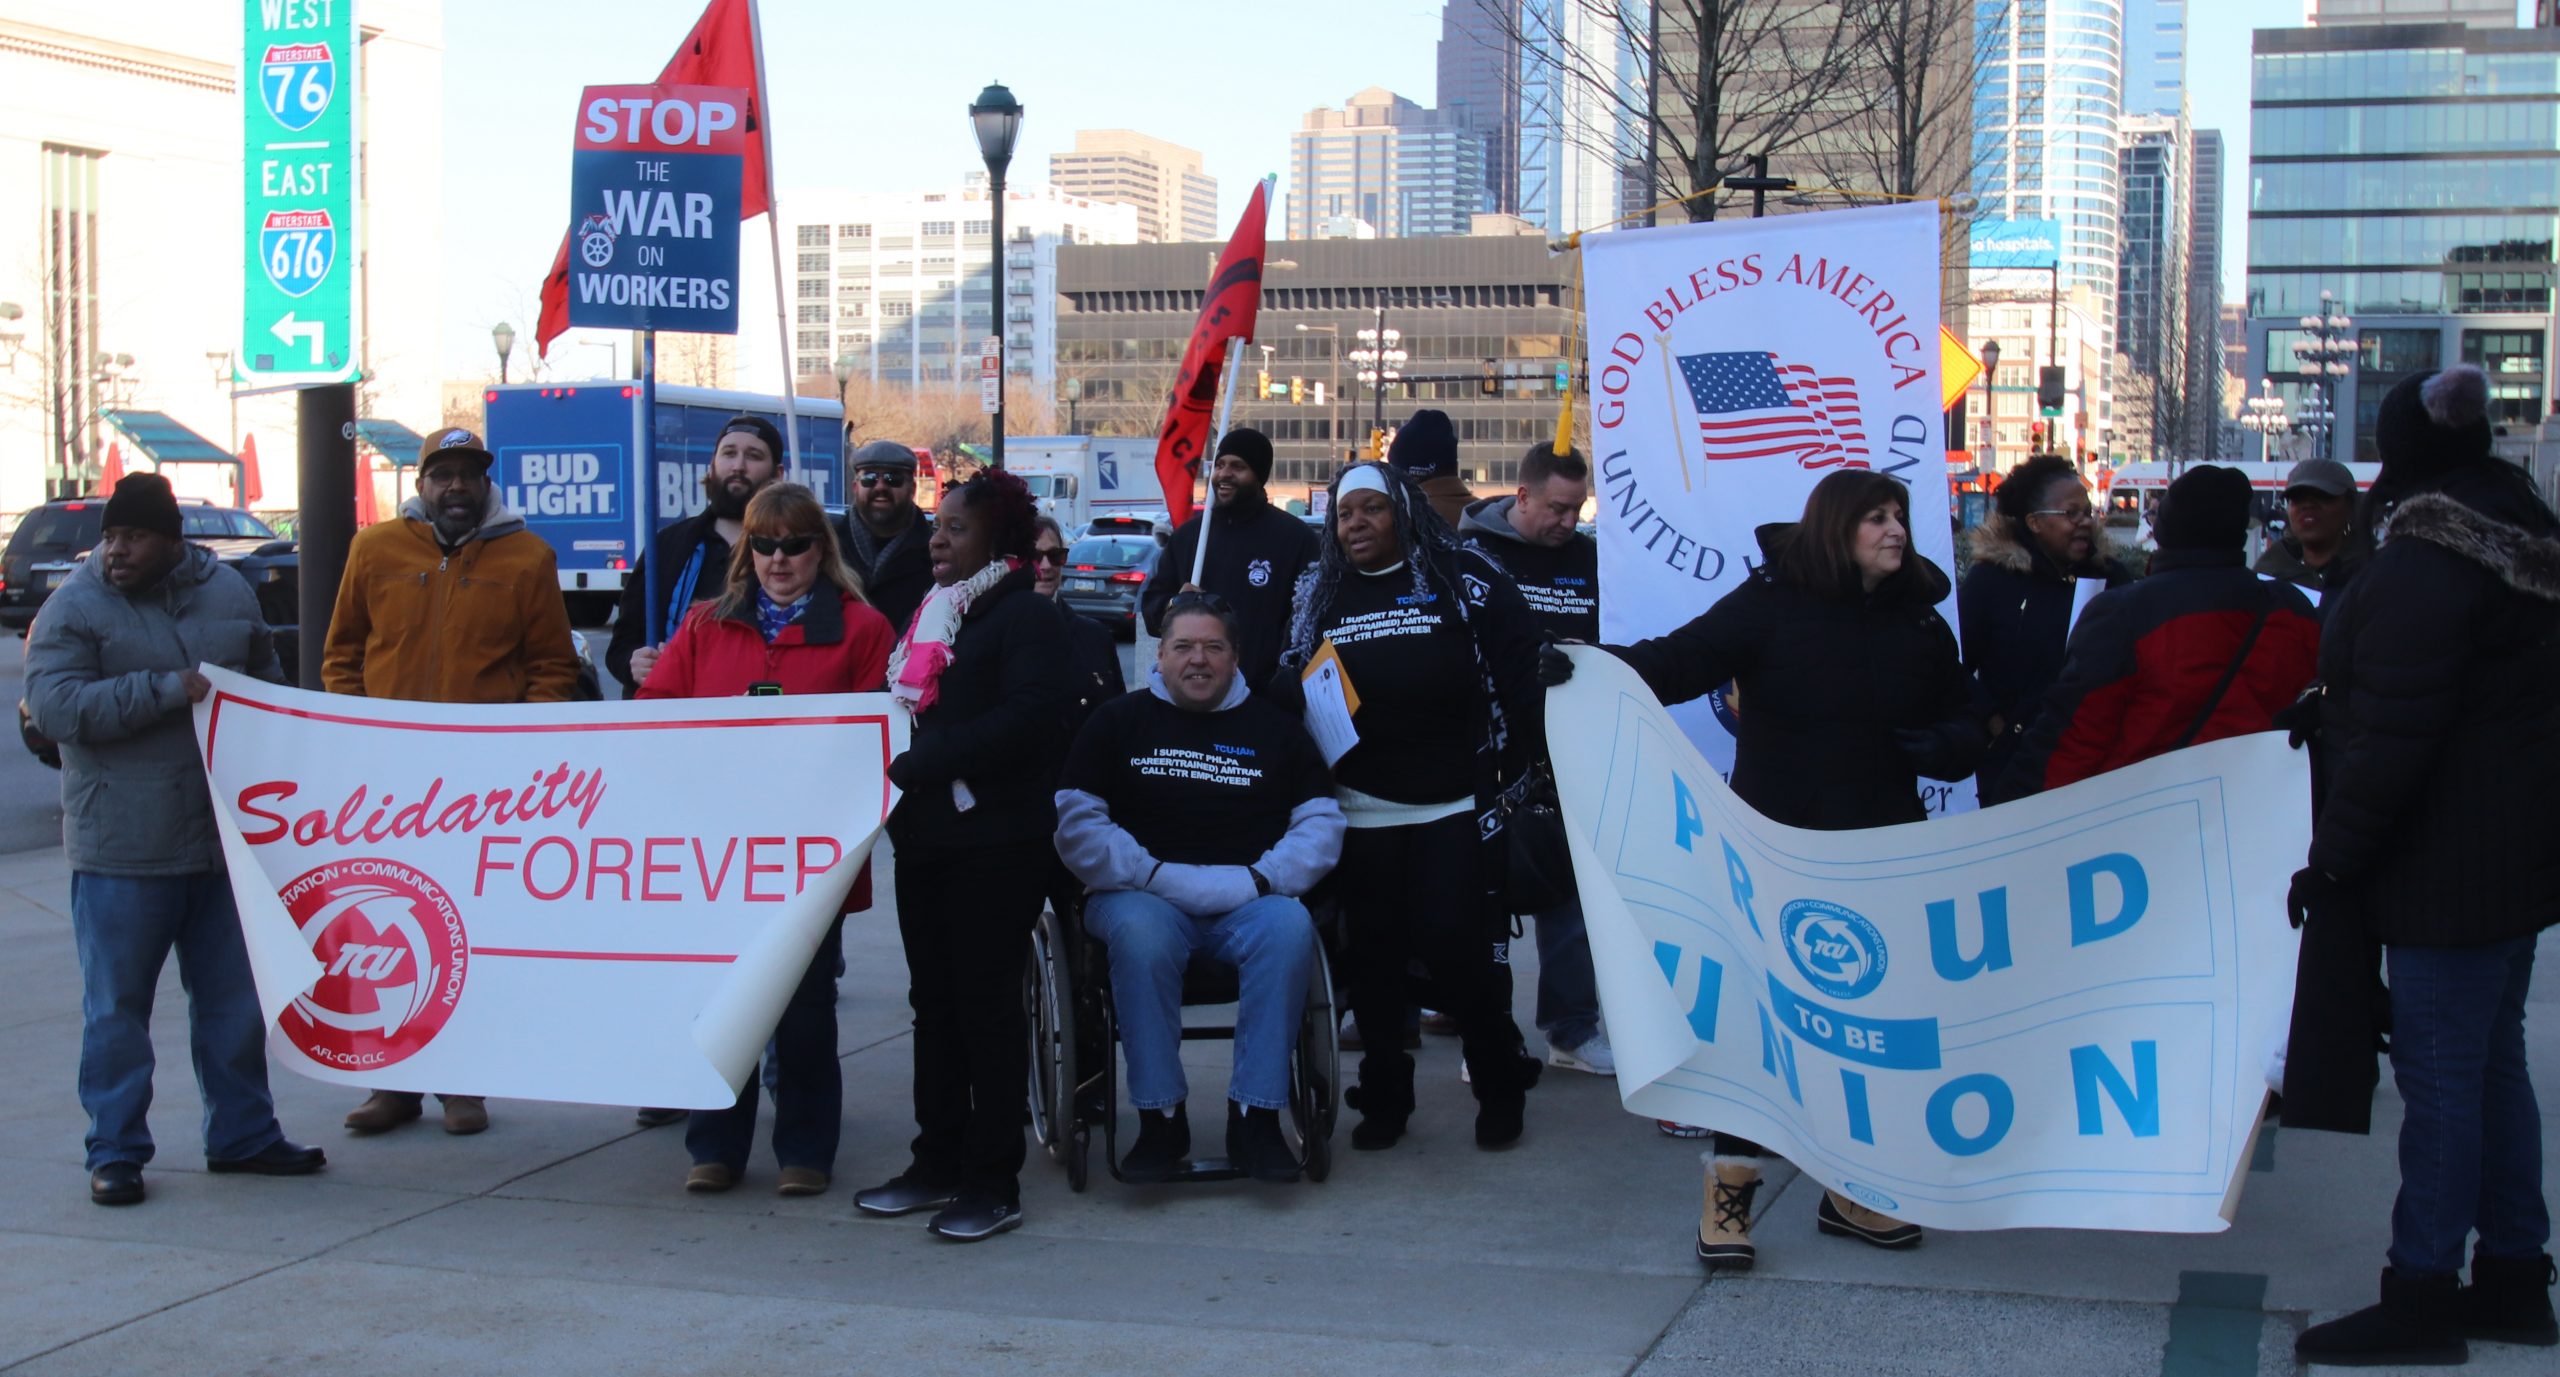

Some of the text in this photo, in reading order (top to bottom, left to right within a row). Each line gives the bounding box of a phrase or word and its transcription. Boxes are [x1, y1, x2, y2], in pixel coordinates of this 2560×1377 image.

[260, 0, 333, 31] WEST
[271, 48, 323, 61] INTERSTATE
[267, 65, 327, 113] 76
[584, 98, 737, 146] STOP
[262, 160, 333, 197] EAST
[636, 161, 670, 182] THE
[271, 215, 323, 227] INTERSTATE
[603, 189, 713, 239] WAR
[271, 232, 324, 279] 676
[638, 246, 664, 267] ON
[578, 273, 730, 310] WORKERS
[1598, 254, 1926, 429] GOD BLESS AMERICA
[521, 453, 600, 485] BUD
[507, 484, 615, 515] LIGHT
[658, 461, 712, 519] BU
[1602, 450, 1724, 581] UNITED
[1346, 611, 1387, 624] SUPPORT
[1388, 608, 1420, 619] PHL,PA
[1402, 615, 1442, 625] AMTRAK
[1332, 625, 1431, 645] CALL CTR EMPLOYEES!
[1154, 748, 1239, 766] I SUPPORT PHL,PA
[1214, 744, 1256, 756] TCU-IAM
[1130, 757, 1263, 778] (CAREER/TRAINED) AMTRAK
[1141, 766, 1251, 786] CALL CTR EMPLOYEES!
[238, 761, 607, 847] Solidarity
[351, 862, 464, 947] COMMUNICATIONS
[442, 948, 465, 1006] UNION
[1814, 939, 1850, 959] TCU
[328, 942, 407, 981] TCU
[1794, 1003, 1886, 1054] TO BE
[1654, 940, 2160, 1157] UNION
